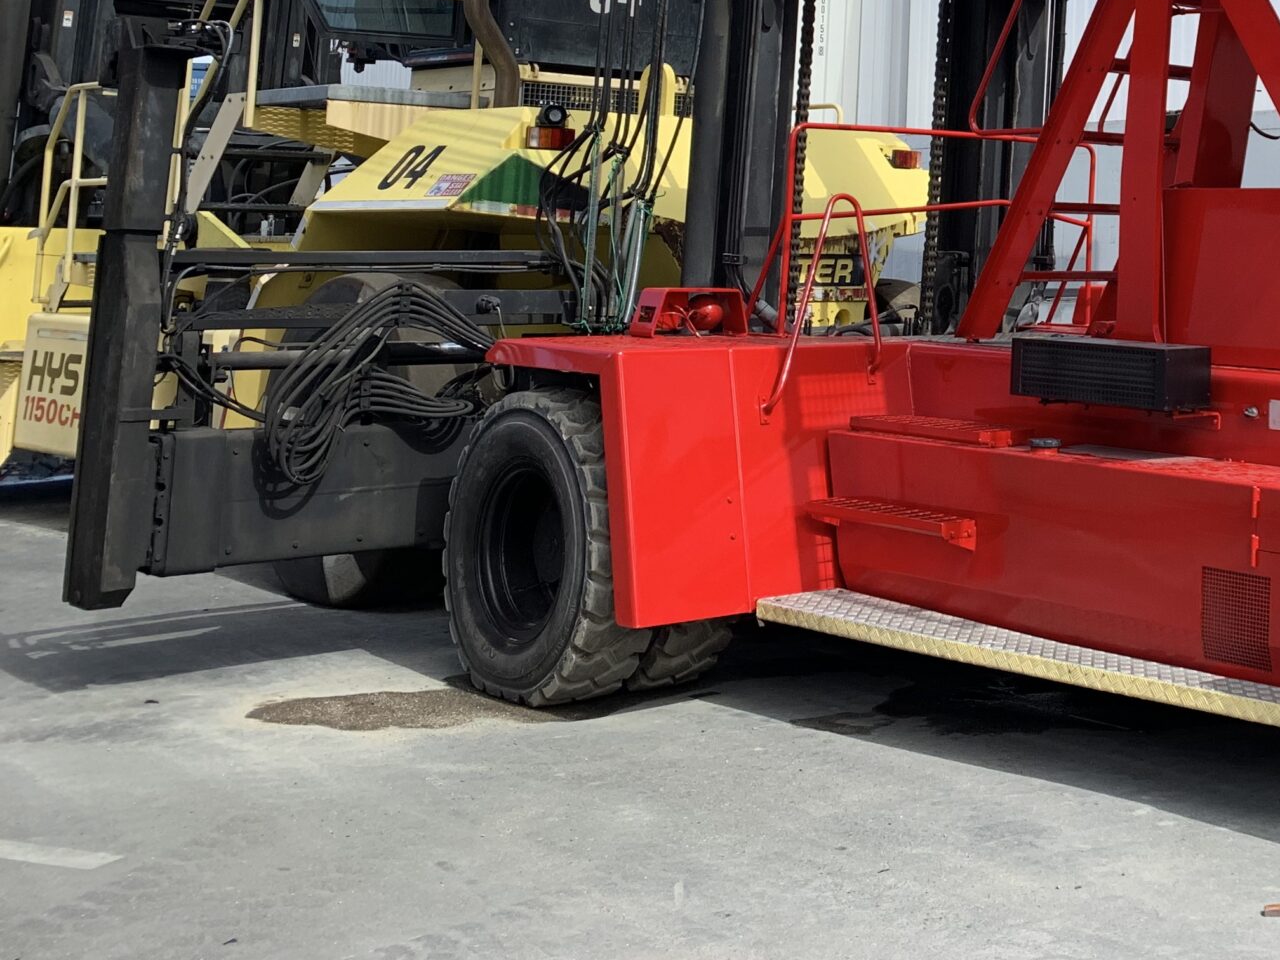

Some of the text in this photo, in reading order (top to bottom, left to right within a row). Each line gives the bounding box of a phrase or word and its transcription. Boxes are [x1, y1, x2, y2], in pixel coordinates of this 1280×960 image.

[377, 144, 448, 191] 04
[798, 258, 853, 283] TER
[27, 349, 83, 396] HYS
